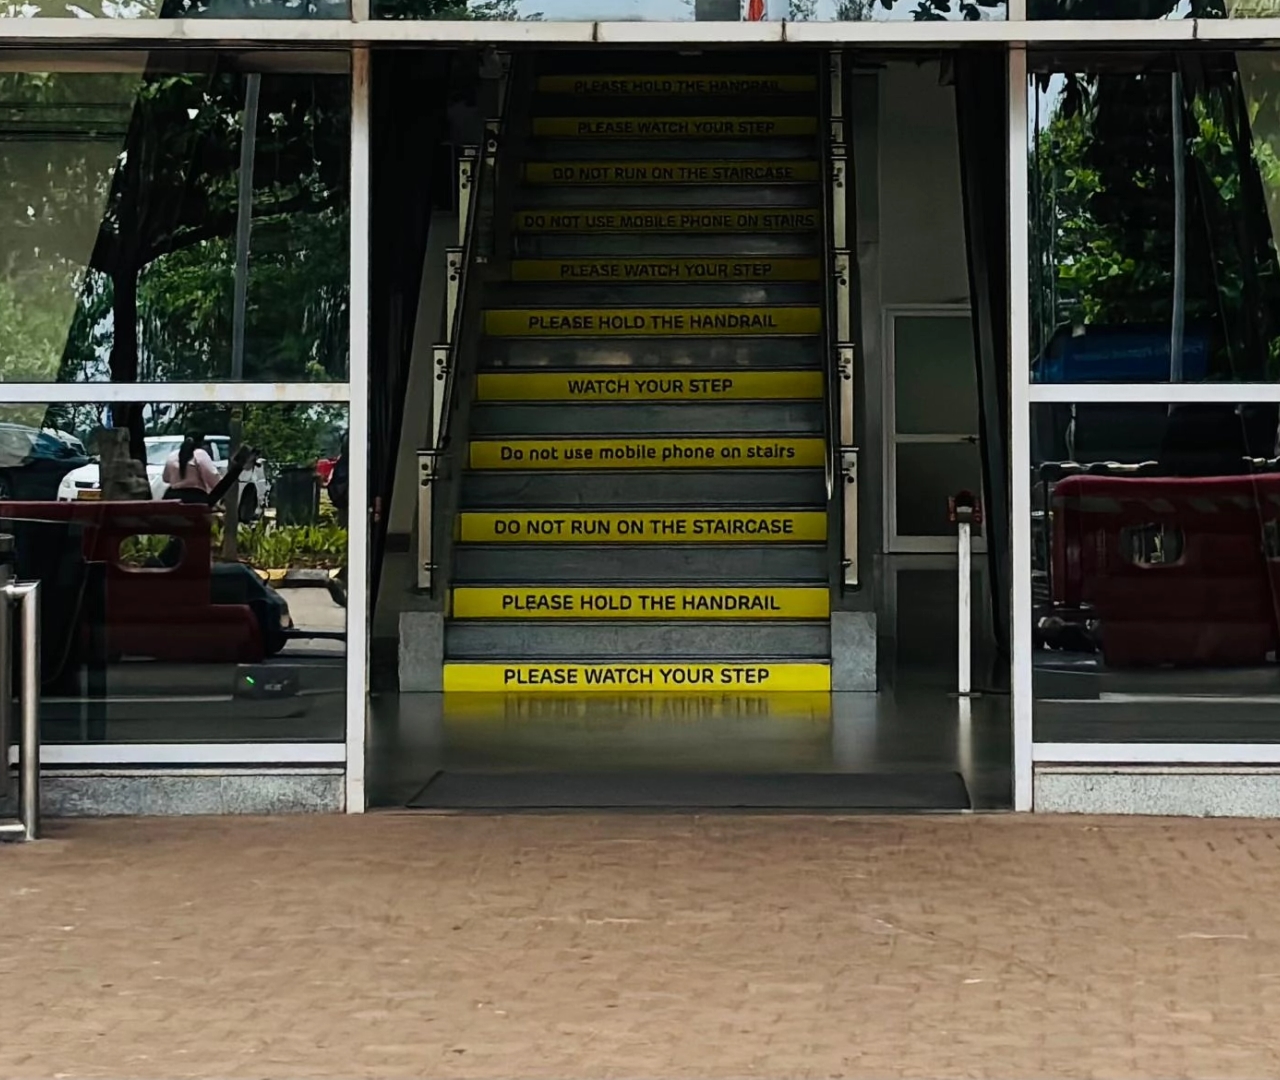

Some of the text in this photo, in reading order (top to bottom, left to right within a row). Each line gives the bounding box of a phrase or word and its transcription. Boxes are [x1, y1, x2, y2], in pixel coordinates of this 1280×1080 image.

[577, 121, 775, 135] PLEASE WATCH YOUR STEP
[553, 167, 794, 181] DO NOT RUN ON THE STAIRCASE
[524, 215, 815, 228] DO NOT USE MOBILE PHONE ON STAIRS
[561, 263, 772, 277] PLEASE WATCH YOUR STEP
[528, 315, 777, 330] PLEASE HOLD THE HANDRAIL
[568, 378, 733, 394] WATCH YOUR STEP
[500, 443, 795, 462] Do not use mobile phone on stairs
[494, 519, 793, 535] DO NOT RUN ON THE STAIRCASE
[502, 594, 780, 611] PLEASE HOLD THE HANDRAIL
[504, 668, 769, 685] PLEASE WATCH YOUR STEP
